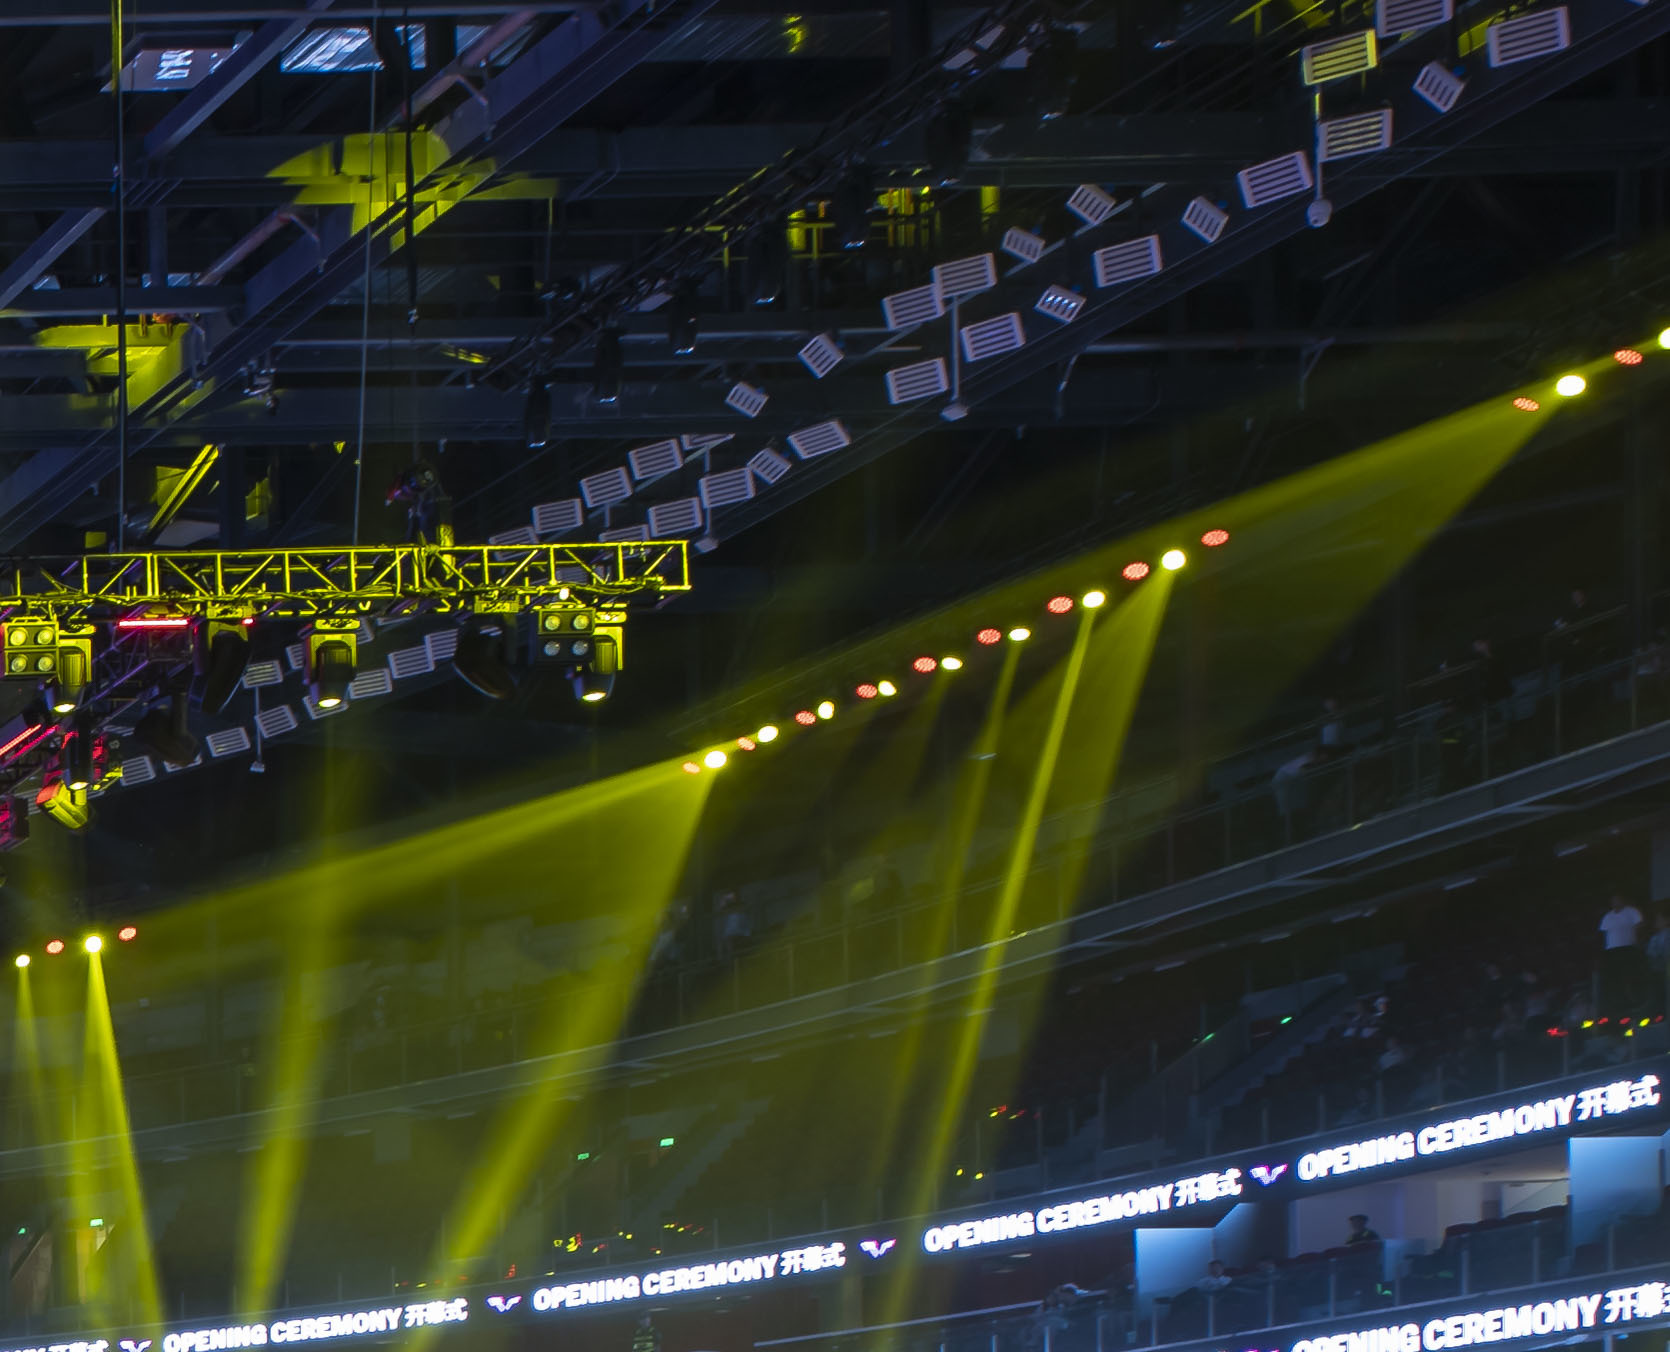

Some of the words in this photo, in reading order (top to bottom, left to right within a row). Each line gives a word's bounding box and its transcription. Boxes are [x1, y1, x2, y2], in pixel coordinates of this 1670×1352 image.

[1297, 1131, 1415, 1181] OPENING
[1417, 1094, 1576, 1155] CEREMONY
[924, 1211, 1035, 1252] OPENING
[1036, 1183, 1174, 1233] CEREMONY
[533, 1275, 641, 1311] OPENING
[642, 1253, 779, 1296] CEREMONY
[1422, 1293, 1602, 1351] CEREMONY
[1604, 1281, 1670, 1323] 开幕
